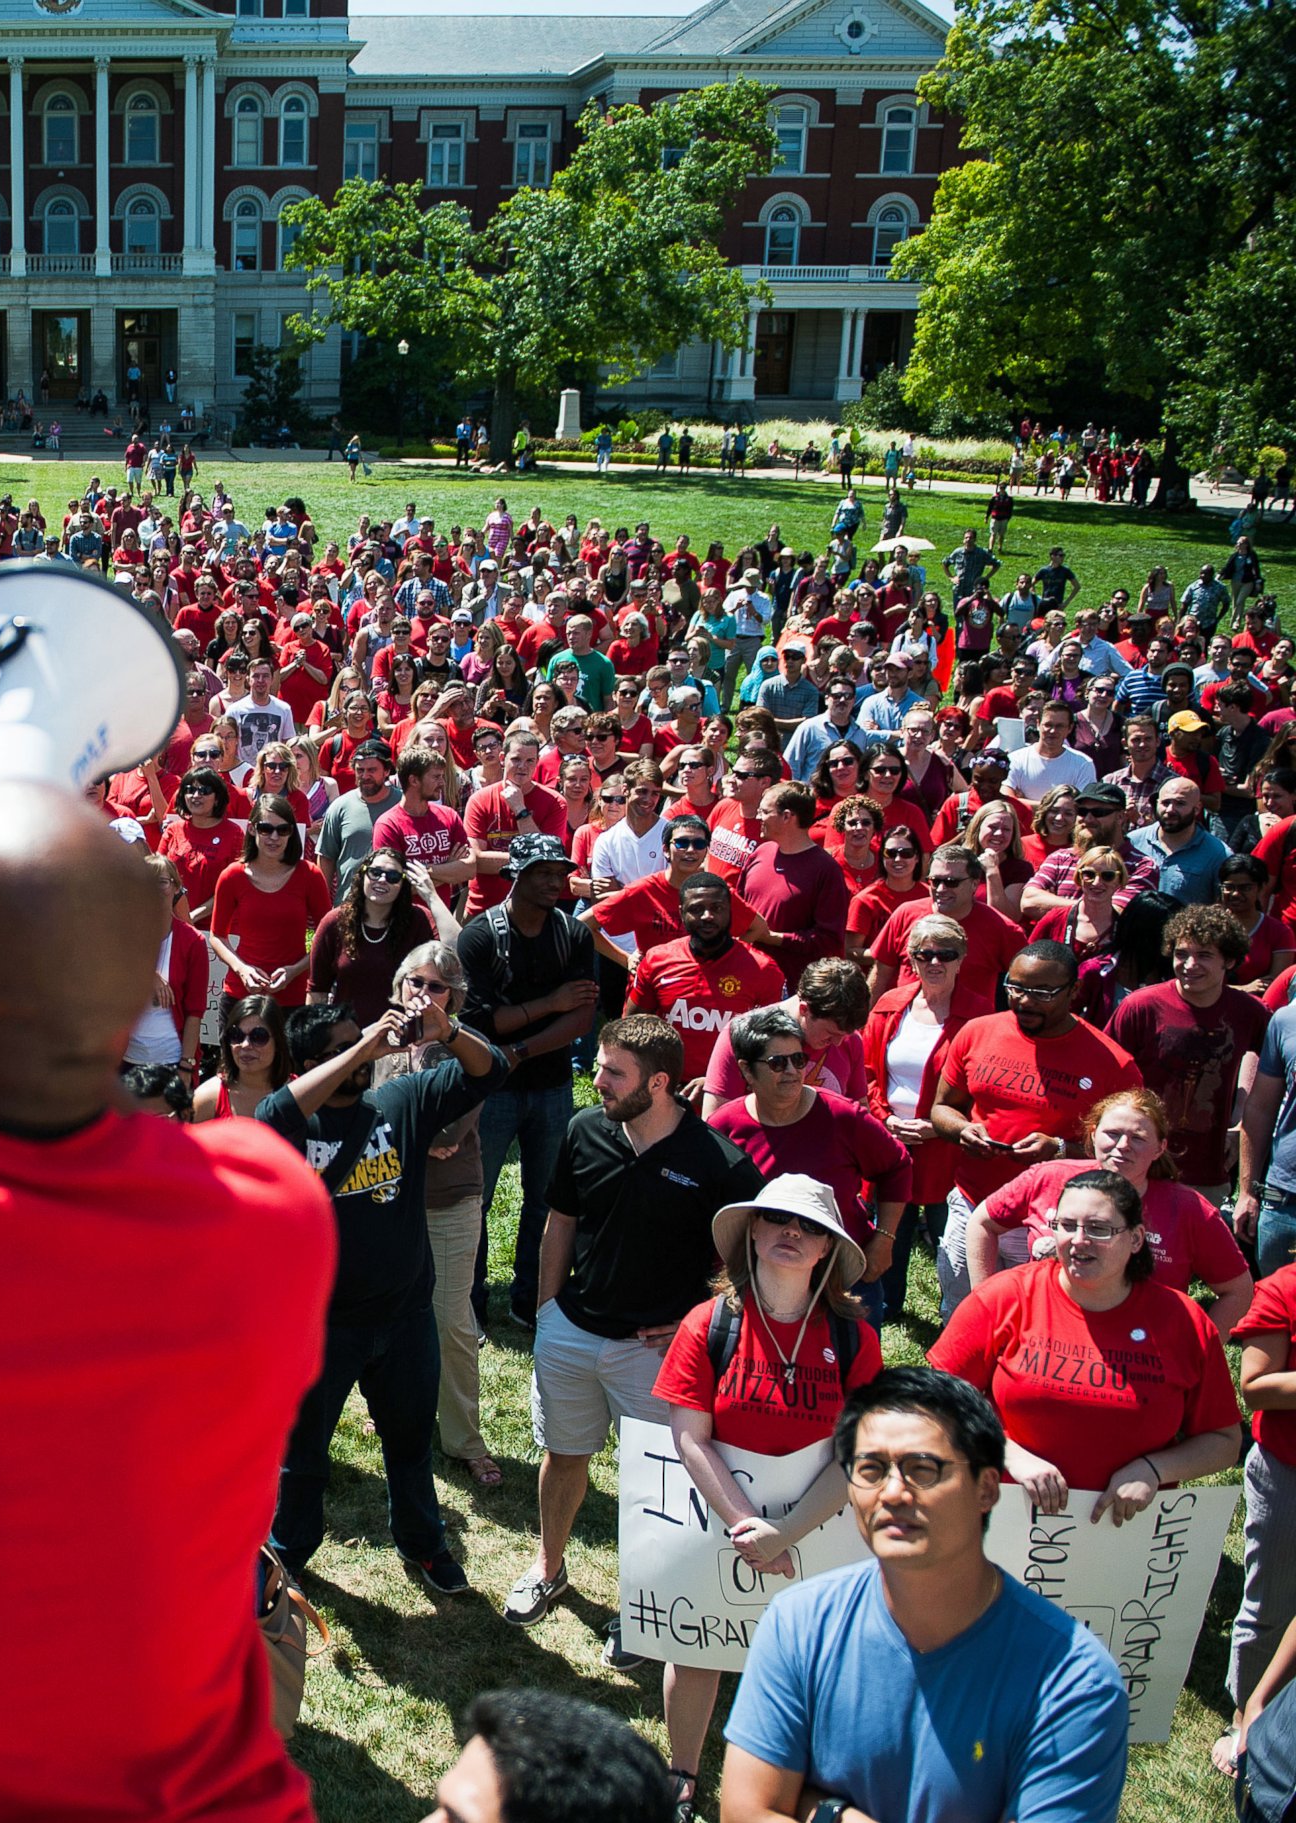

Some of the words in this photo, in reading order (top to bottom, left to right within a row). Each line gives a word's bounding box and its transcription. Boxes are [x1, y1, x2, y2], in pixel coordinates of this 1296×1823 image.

[972, 1063, 1051, 1098] MIZZOU
[1018, 1347, 1129, 1391] MIZZOU
[1028, 1335, 1095, 1360] GRADUATE
[1101, 1348, 1165, 1371] STUDENTS
[719, 1369, 818, 1411] MIZZOU
